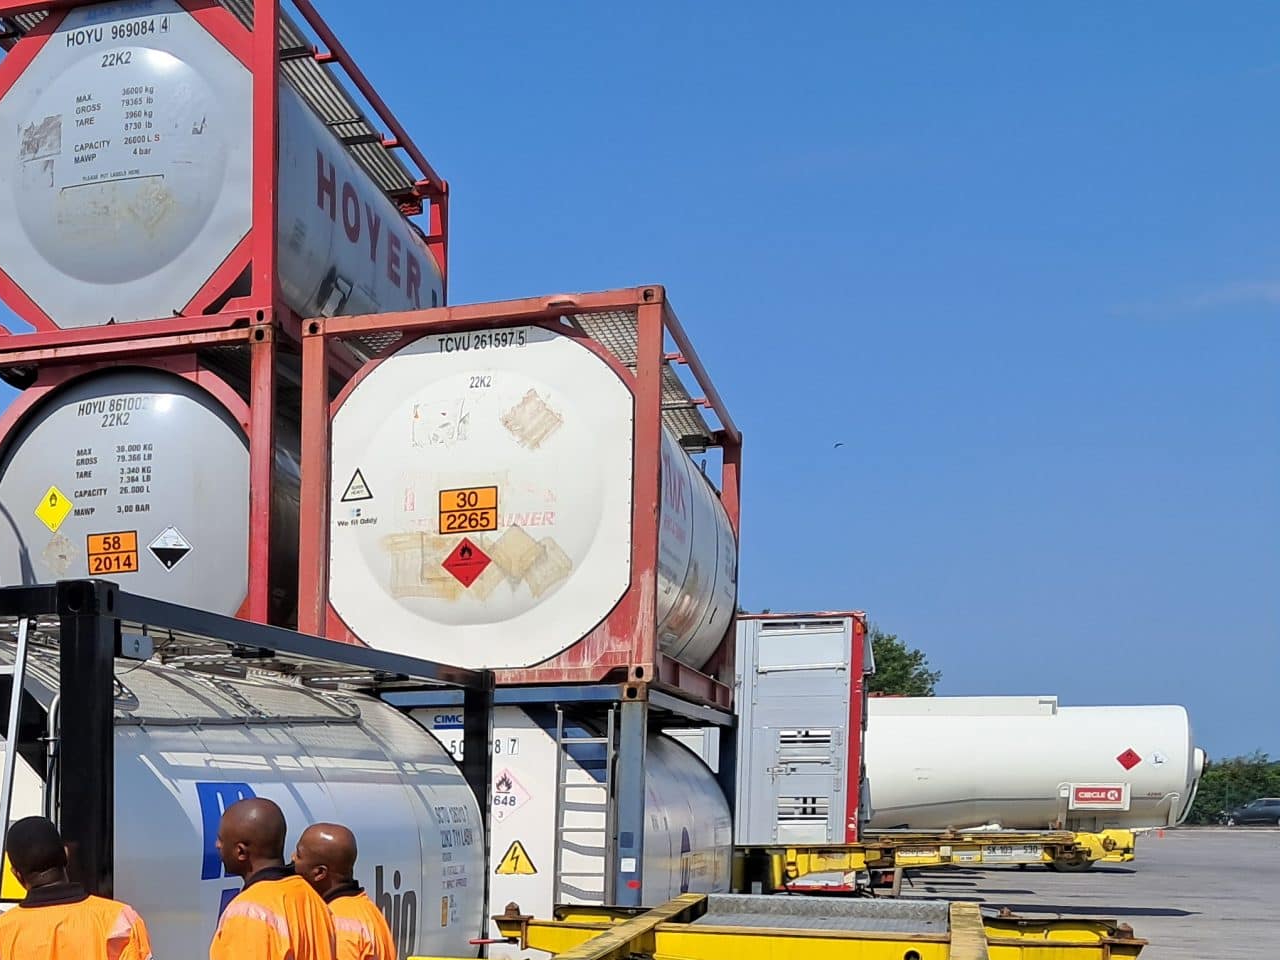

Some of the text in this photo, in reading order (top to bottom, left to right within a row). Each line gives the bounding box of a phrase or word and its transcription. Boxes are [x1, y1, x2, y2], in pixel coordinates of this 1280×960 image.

[66, 16, 168, 47] HOYU 969084 4
[101, 51, 132, 68] 22K2
[144, 86, 154, 95] kg
[76, 94, 92, 104] MAX
[75, 103, 101, 115] GROSS
[75, 117, 95, 128] TARE
[74, 140, 111, 152] CAPACITY
[154, 133, 160, 142] S
[74, 153, 97, 164] MAWP
[316, 147, 422, 310] HOYER
[438, 330, 525, 353] TCVU 261597 5
[469, 376, 491, 388] 22K2
[78, 401, 105, 416] HOYU
[101, 412, 130, 428] 22K2
[76, 448, 92, 456] MAX
[76, 457, 98, 466] GROSS
[76, 471, 92, 479] TARE
[74, 488, 108, 498] CAPACITY
[456, 491, 478, 508] 30
[74, 507, 95, 517] MAWP
[135, 504, 150, 512] BAR
[446, 511, 490, 530] 2265
[102, 536, 121, 551] 58
[94, 554, 132, 572] 2014
[433, 715, 463, 724] CIMC
[510, 739, 517, 754] 7
[493, 795, 517, 806] 648
[1078, 790, 1118, 800] CIRCLE K
